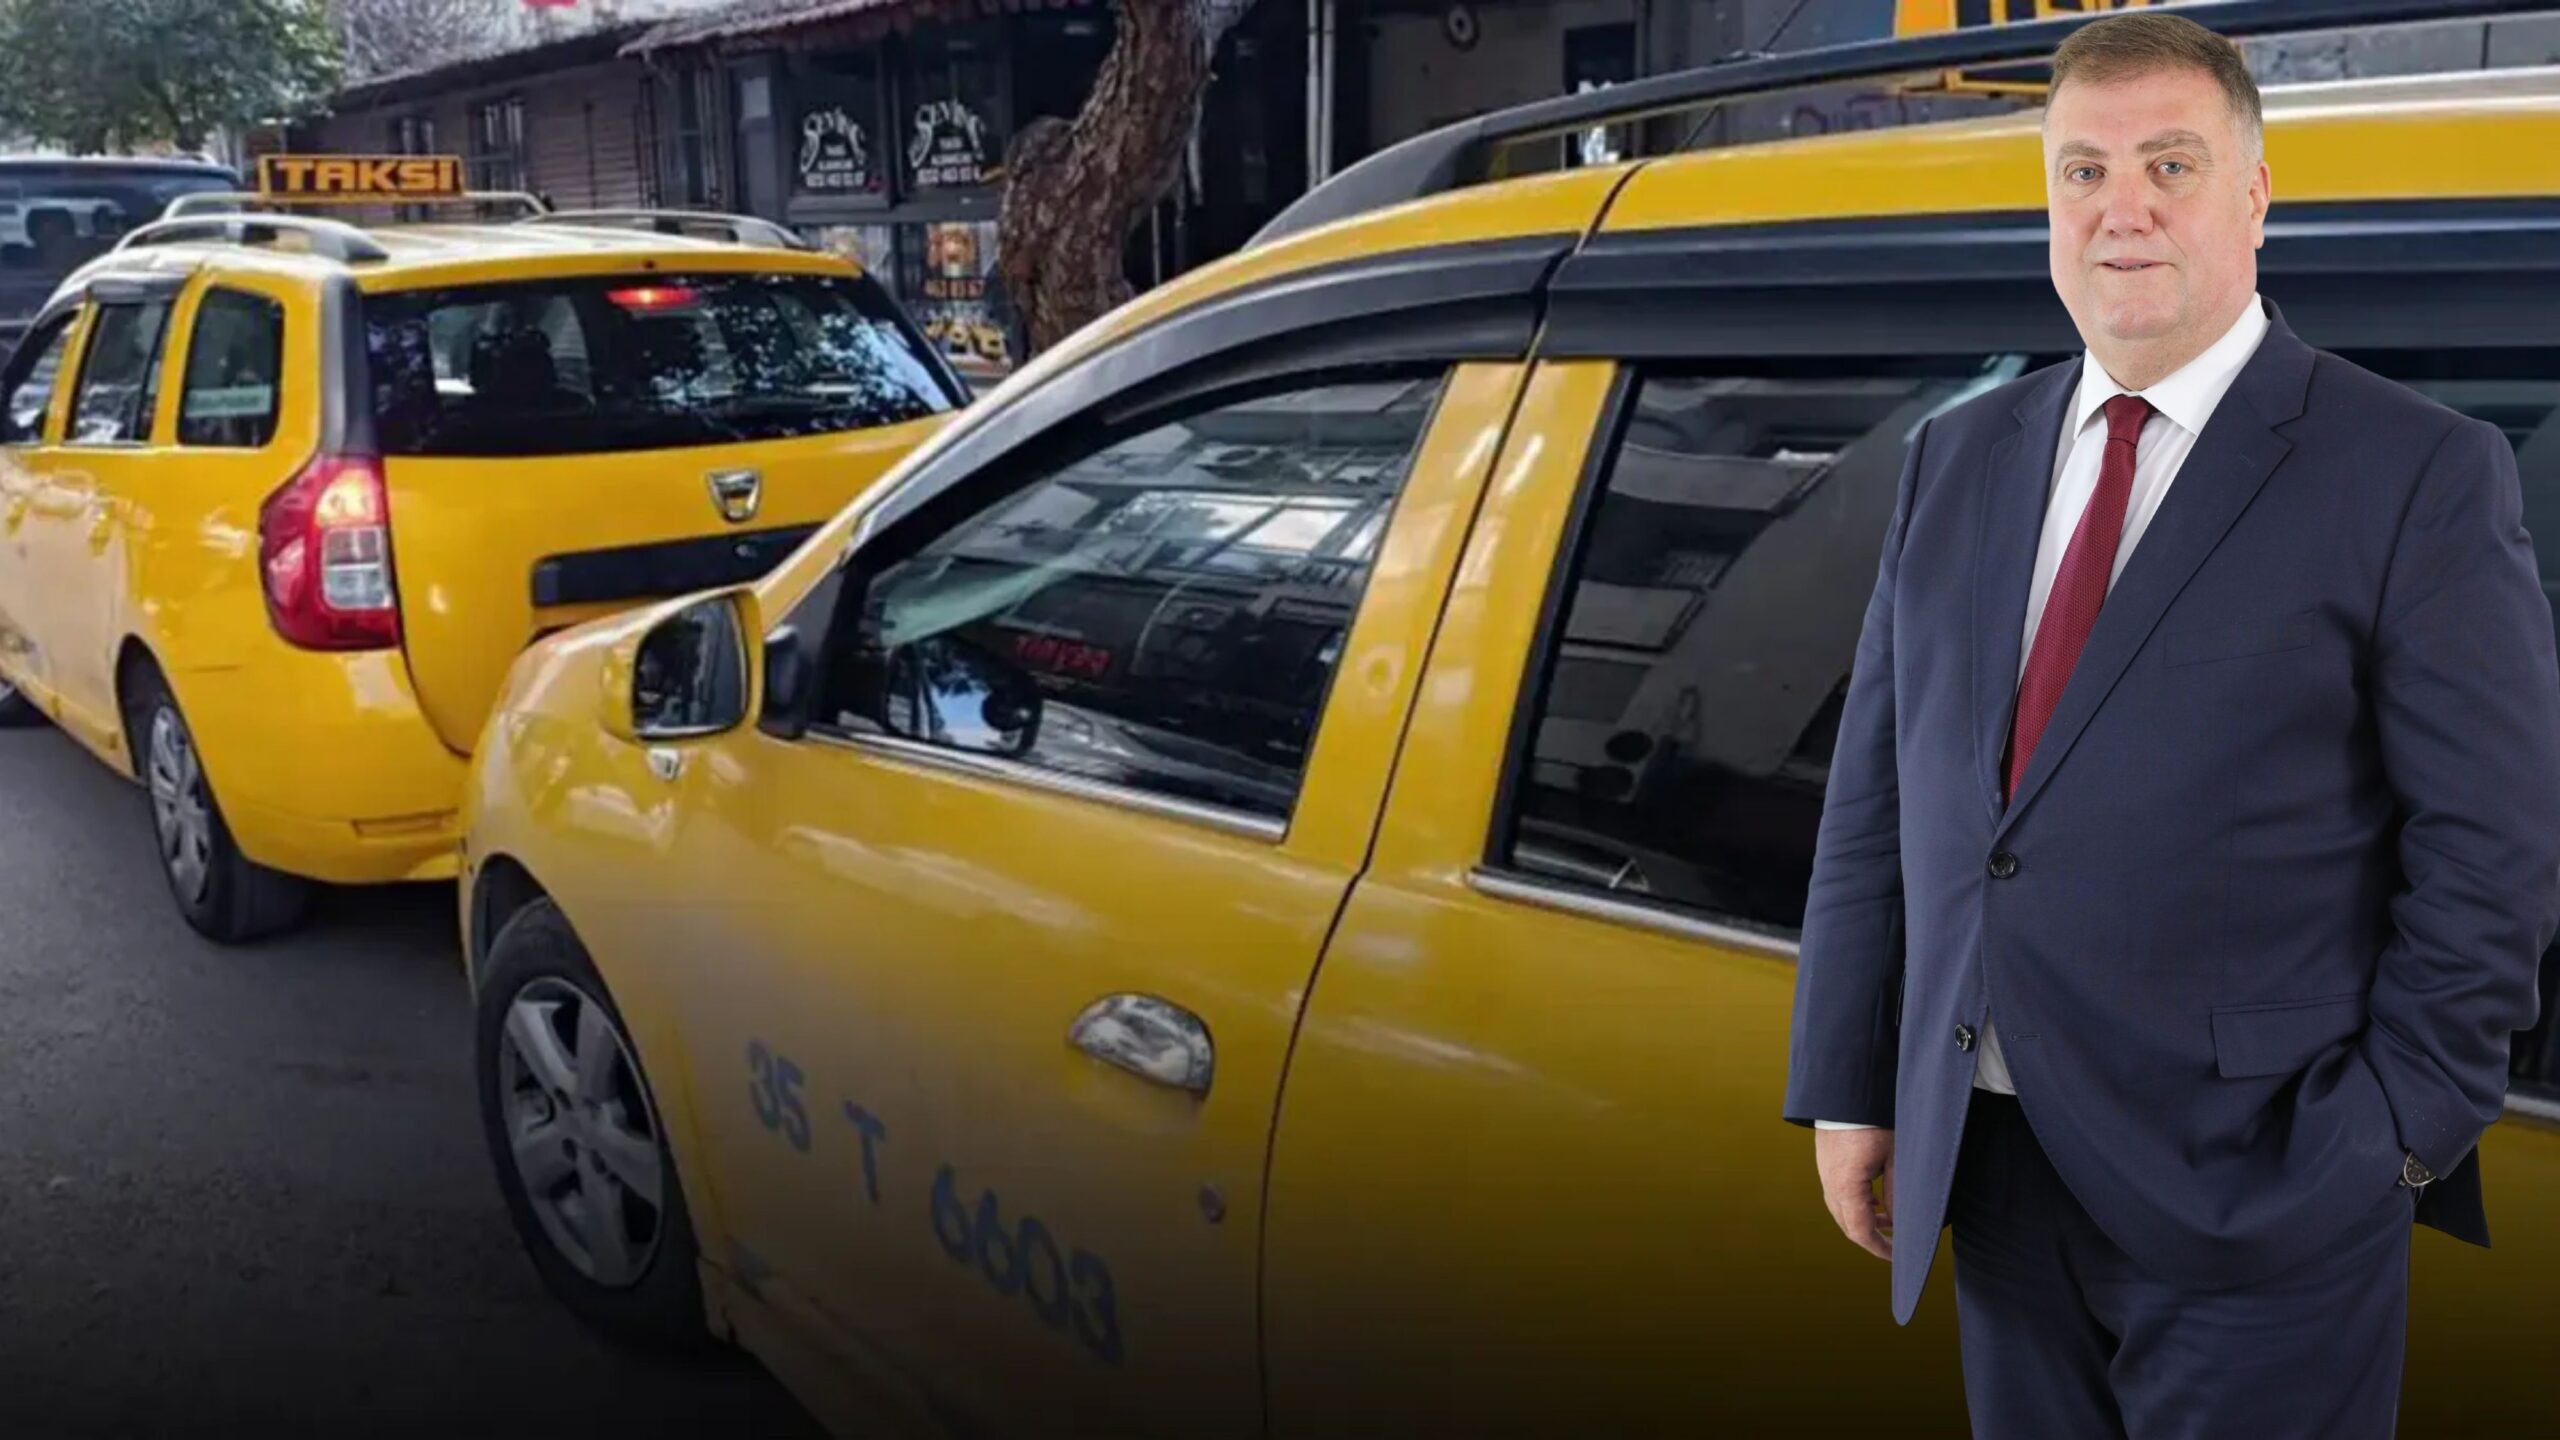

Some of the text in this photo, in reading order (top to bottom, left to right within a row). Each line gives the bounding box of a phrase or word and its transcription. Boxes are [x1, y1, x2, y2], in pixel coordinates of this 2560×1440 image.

[275, 159, 453, 191] TAKSI
[747, 1040, 1123, 1365] 35 T 6603
